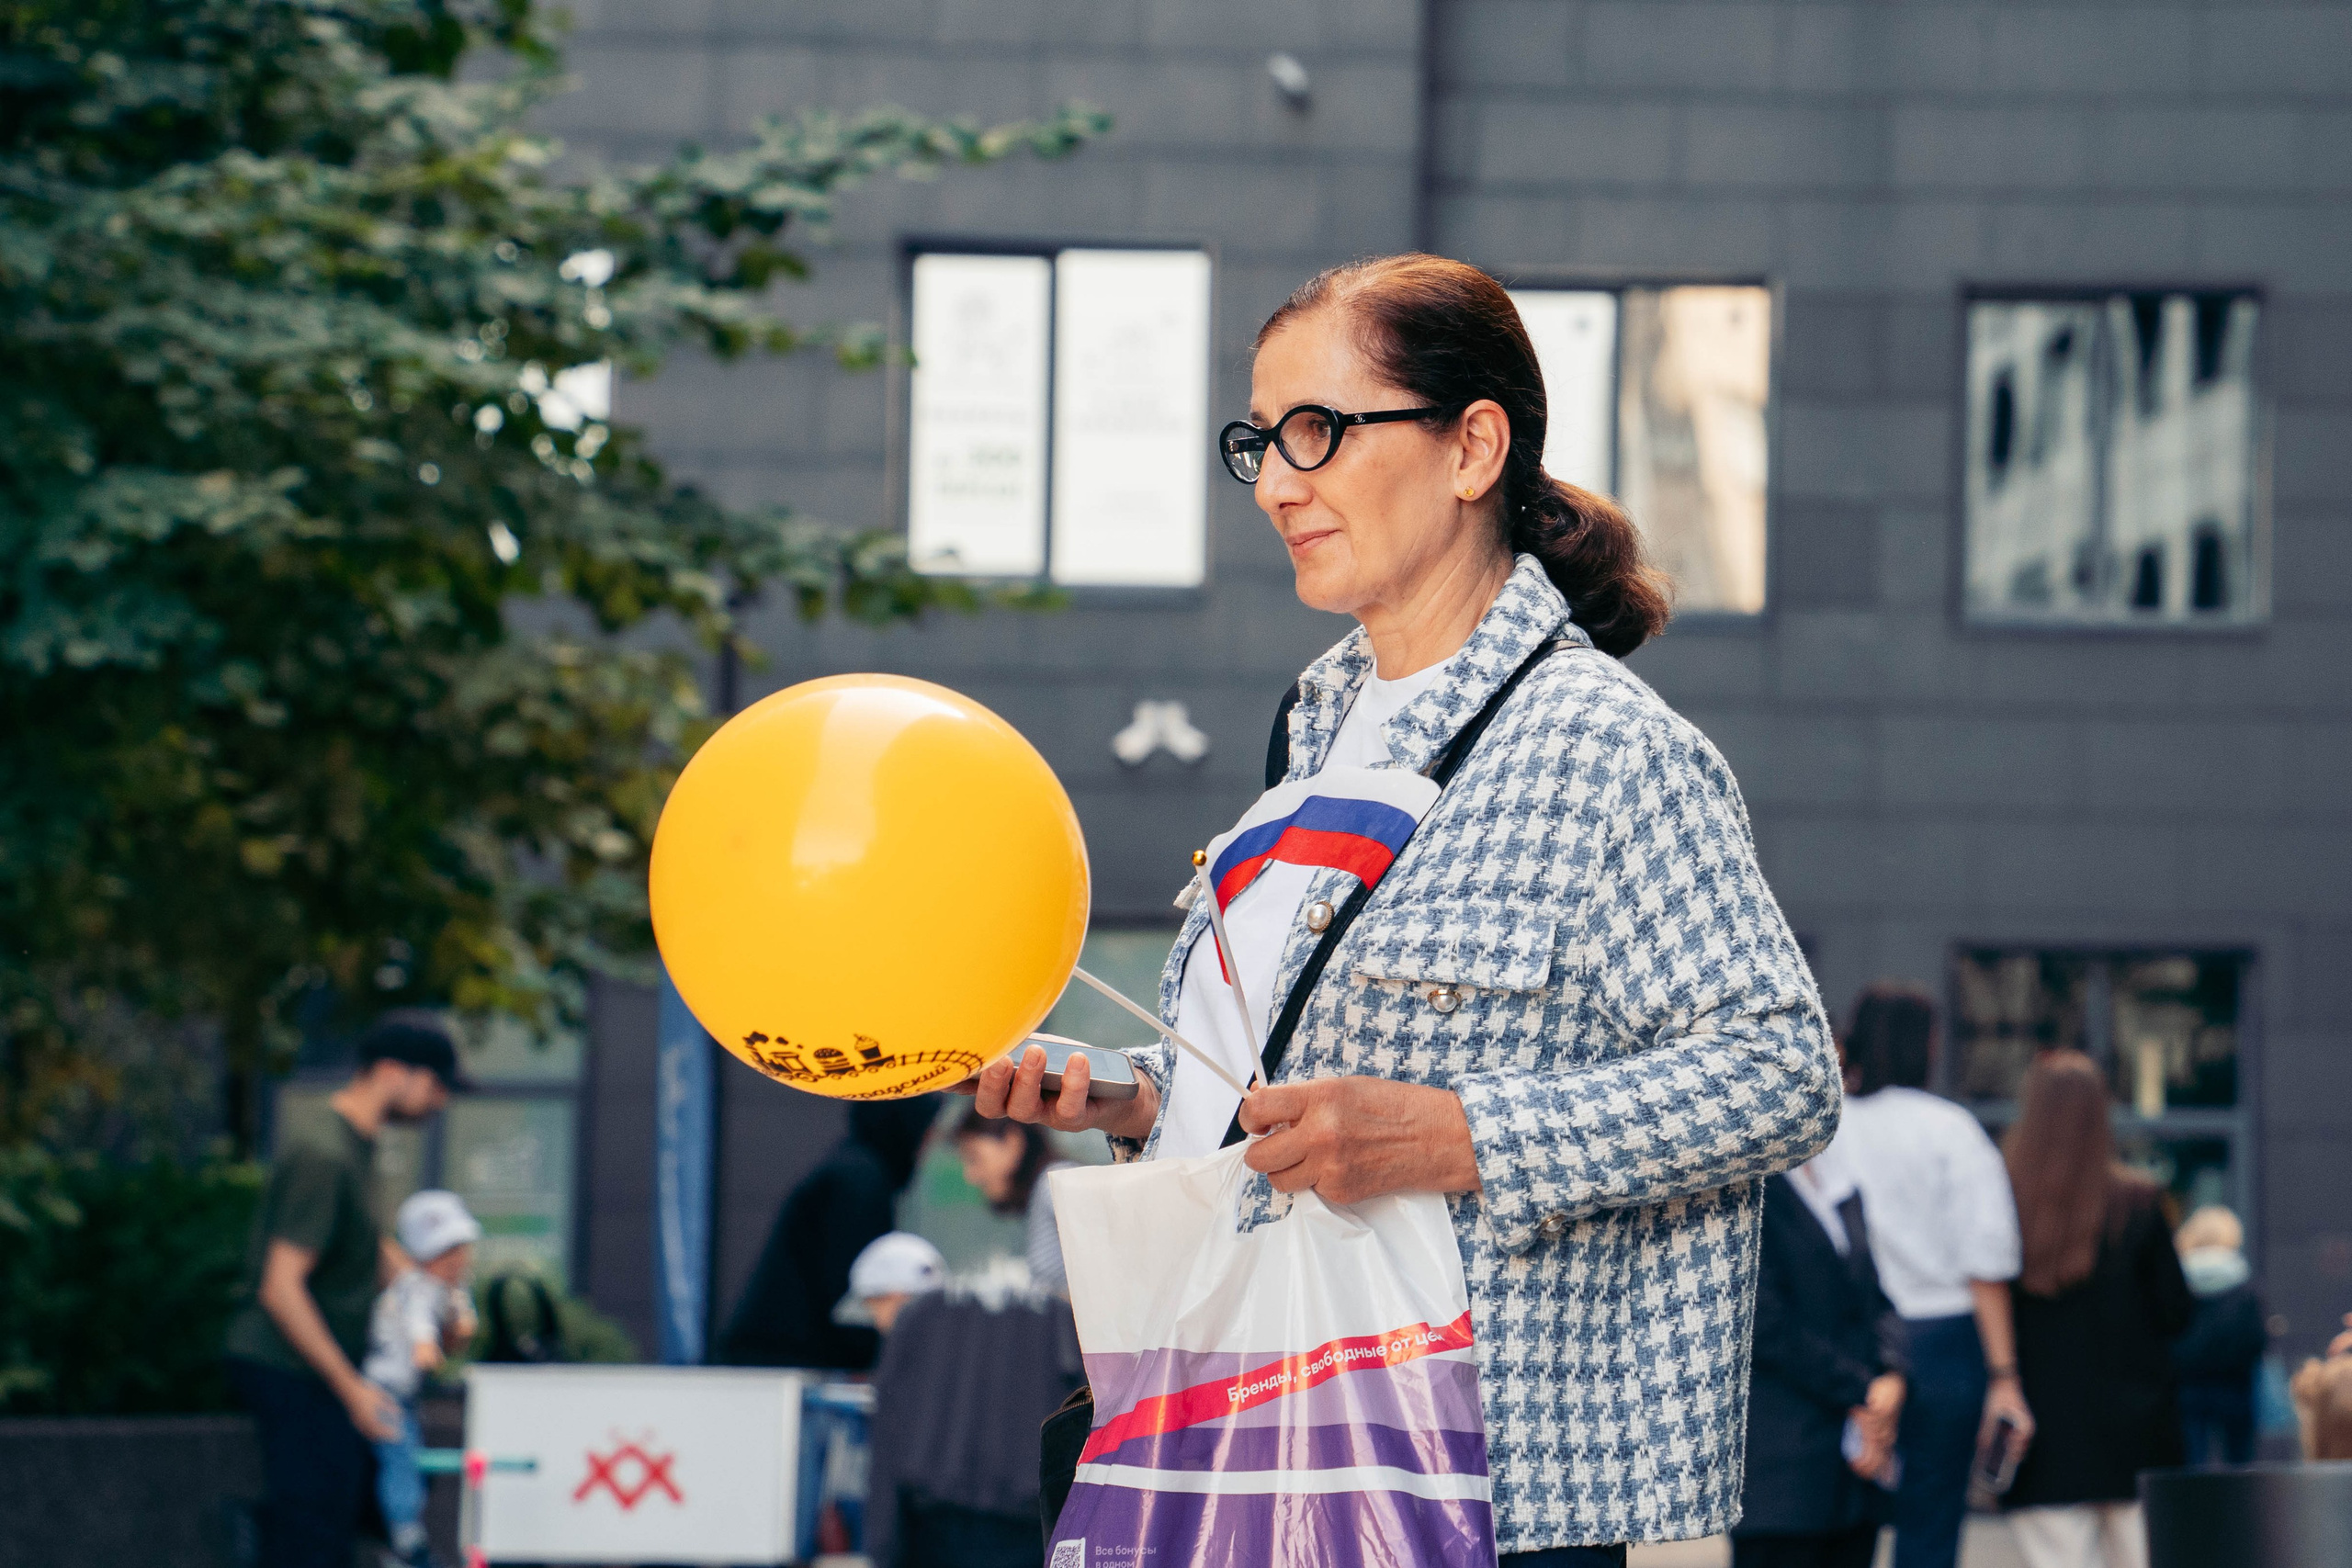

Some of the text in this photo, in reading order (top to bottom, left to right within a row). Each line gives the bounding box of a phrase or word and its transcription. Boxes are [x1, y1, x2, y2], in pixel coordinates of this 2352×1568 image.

[1227, 1369, 1298, 1403] Бренды,
[1301, 1346, 1387, 1378] свободные
[1391, 1337, 1411, 1352] от
[1095, 1544, 1157, 1558] Все бонусы
